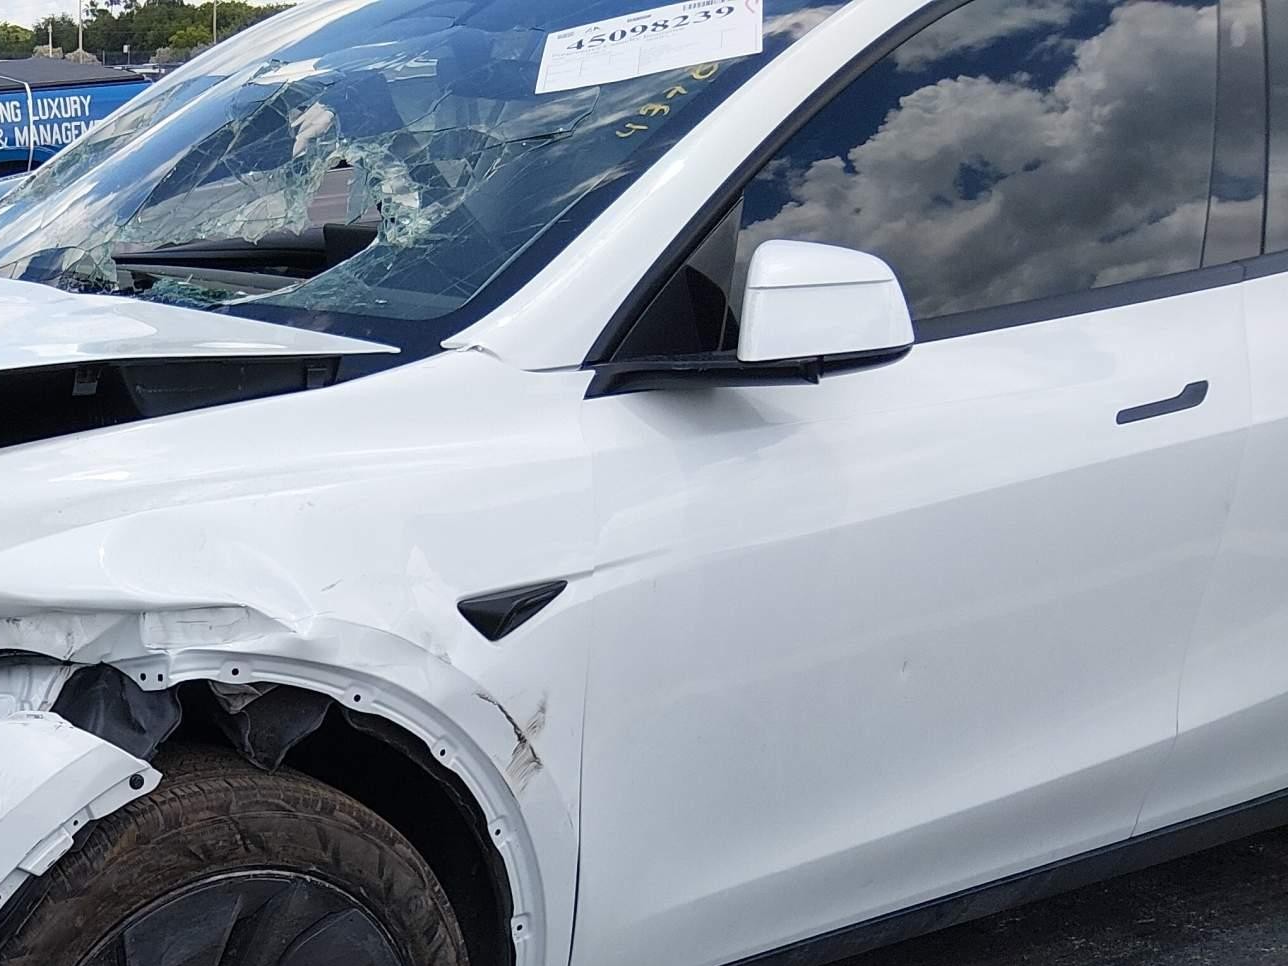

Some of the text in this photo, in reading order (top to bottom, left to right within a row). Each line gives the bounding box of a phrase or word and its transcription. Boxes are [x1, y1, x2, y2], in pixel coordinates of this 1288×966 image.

[566, 5, 735, 50] 45098239
[30, 95, 91, 120] LUXURY
[15, 119, 103, 147] MANAGEM
